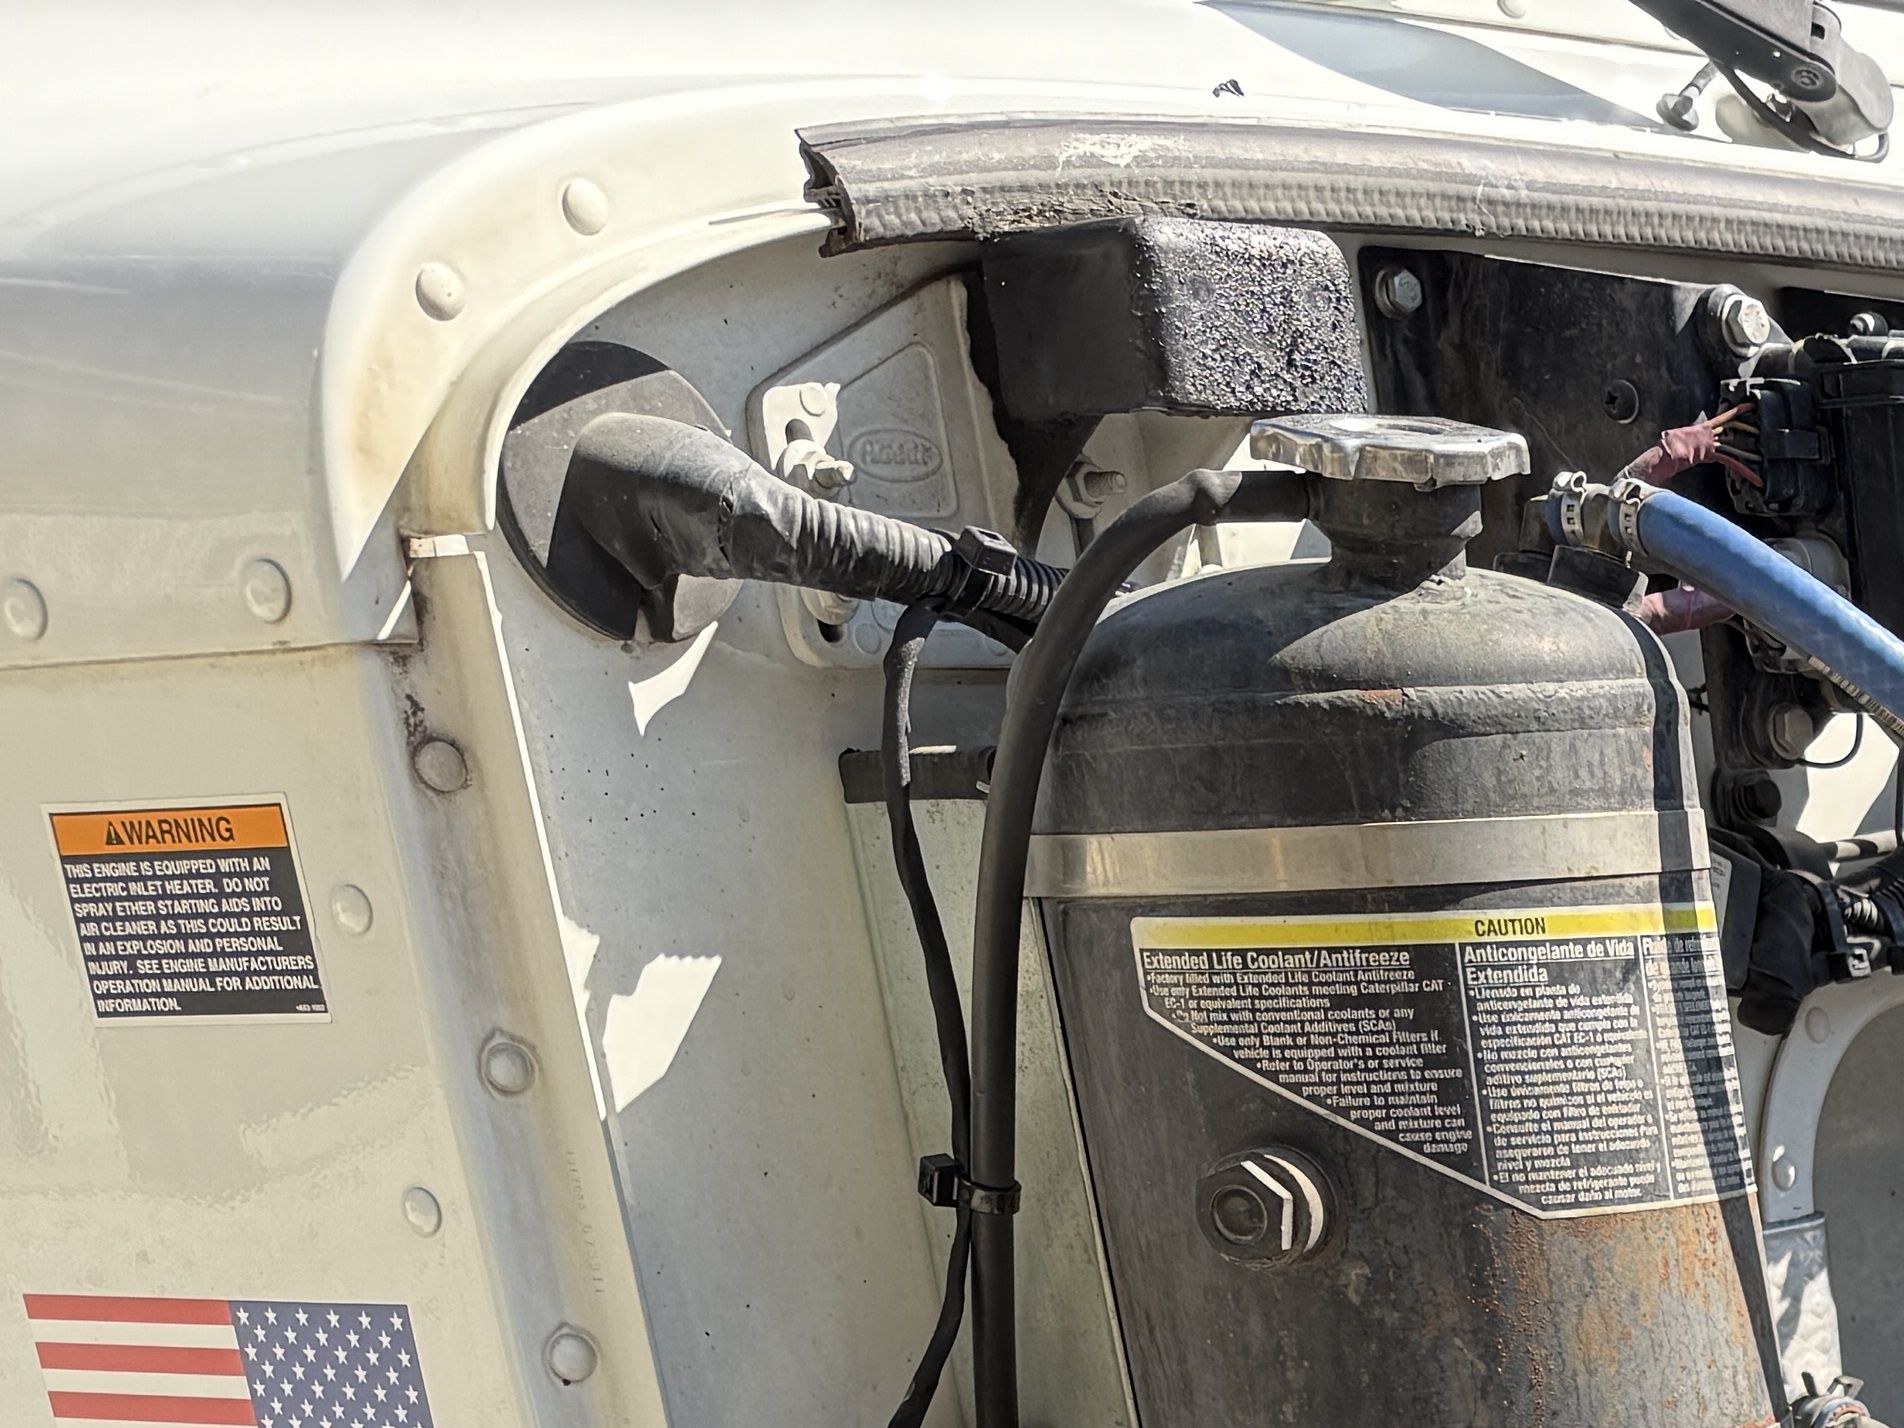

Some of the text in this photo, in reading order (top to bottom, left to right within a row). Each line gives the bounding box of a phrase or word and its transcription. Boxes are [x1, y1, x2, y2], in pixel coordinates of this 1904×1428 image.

[124, 817, 234, 844] WARNING
[64, 857, 270, 878] THIS ENGINE IS EQUIPPED WITH AN
[70, 877, 269, 897] ELECTRIC INLET HEATER. DO NOT
[73, 897, 281, 917] SPRAY ETHER STARTING AIDS INTO
[80, 915, 301, 937] AIR CLEANER AS THIS COULD RESULT
[1475, 917, 1546, 937] CAUTION
[84, 936, 283, 955] IN AN EXPLOSION AND PERSONAL
[1464, 939, 1634, 963] Anticongelante de Vida
[88, 955, 314, 975] INJURY. SEE ENGINE MANUFACTURERS
[1143, 949, 1410, 970] Extended Life Coolant/Antifreeze
[1466, 965, 1549, 984] Extendida
[93, 979, 163, 994] OPERATION
[163, 978, 215, 992] MANUAL
[217, 976, 242, 991] FOR
[97, 997, 181, 1012] INFORMATION.
